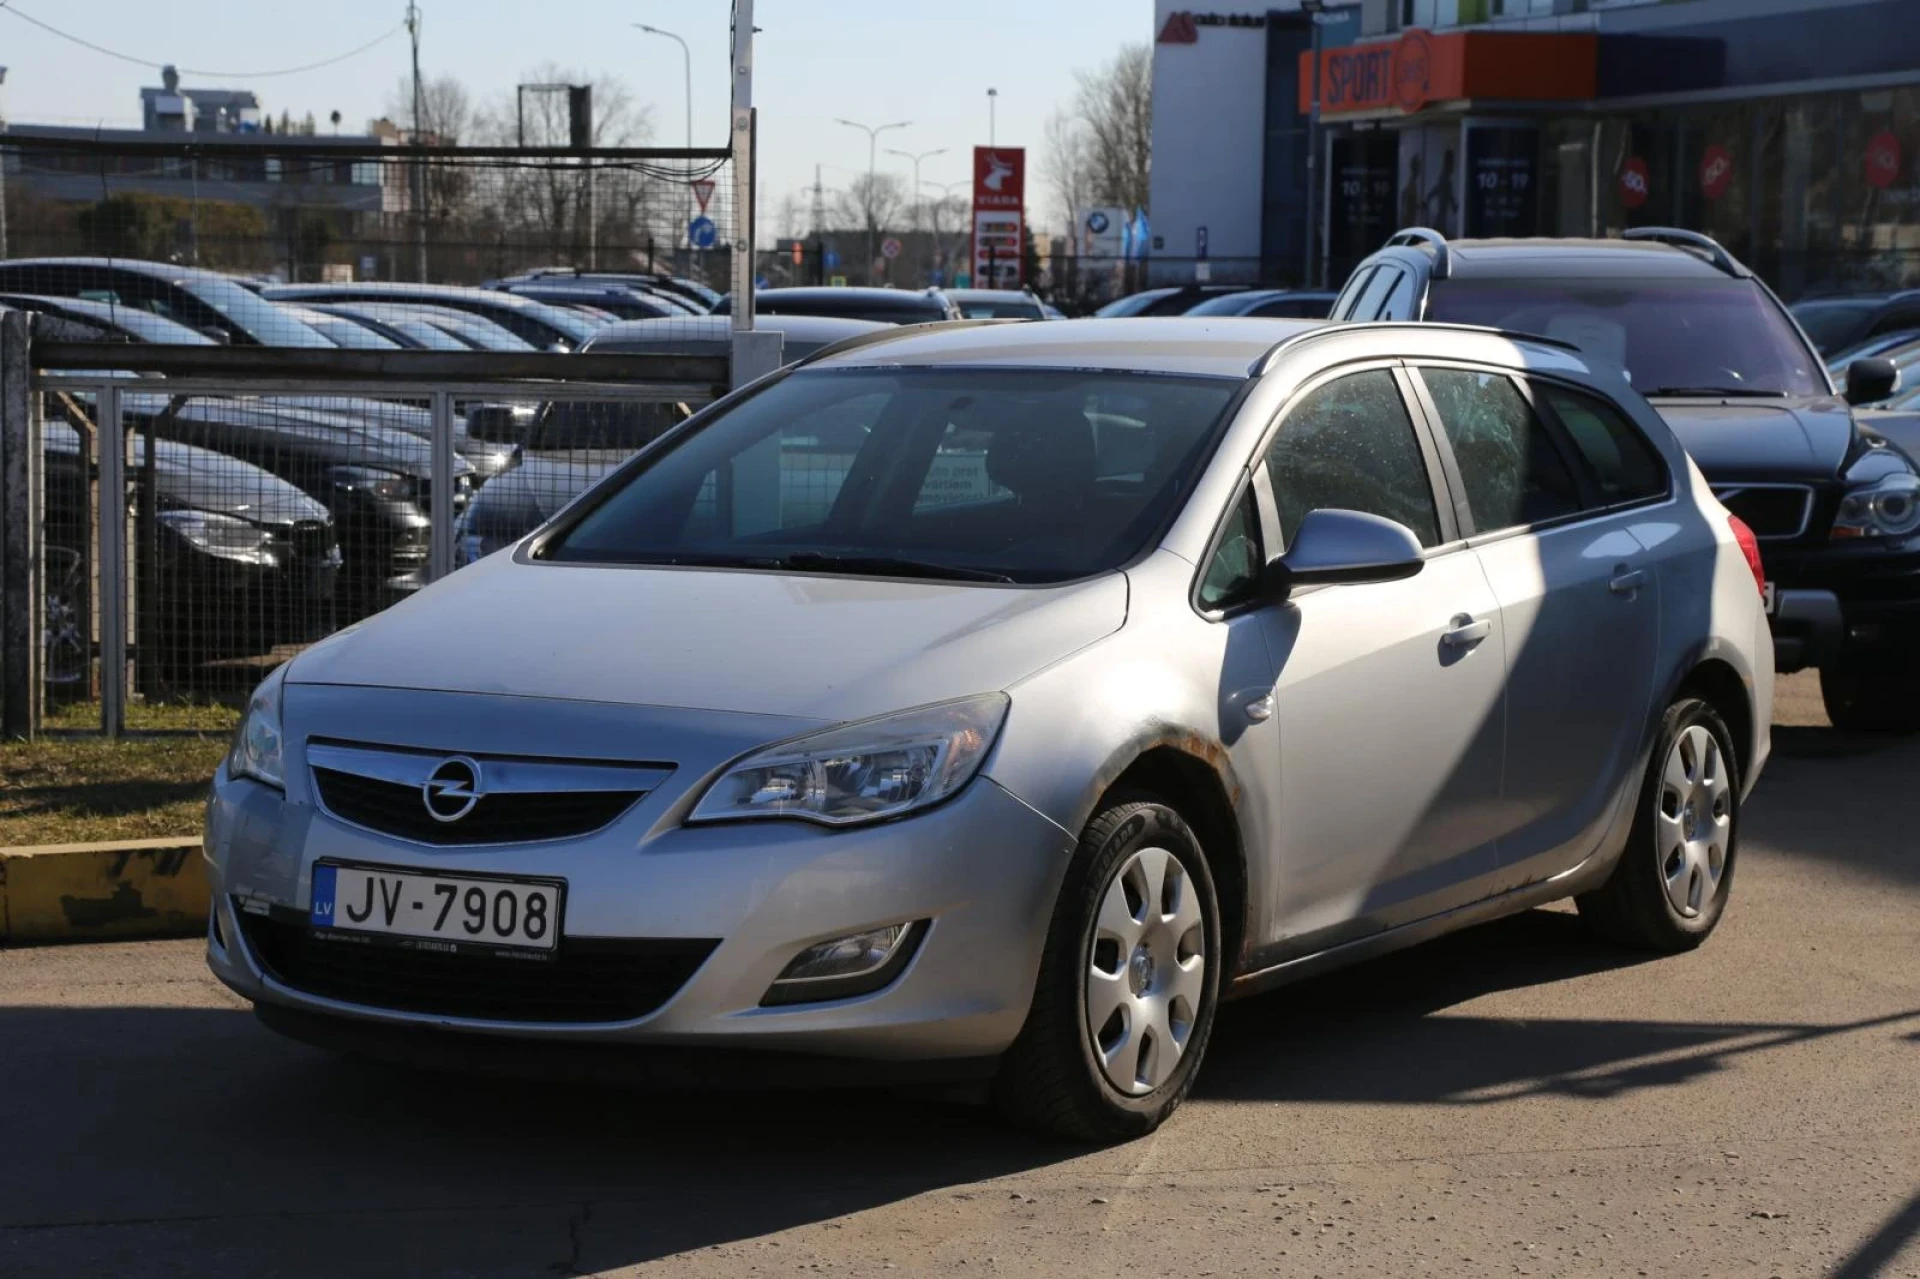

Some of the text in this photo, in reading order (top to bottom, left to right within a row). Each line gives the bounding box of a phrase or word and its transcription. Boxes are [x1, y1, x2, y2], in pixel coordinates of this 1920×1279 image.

[1328, 49, 1391, 104] SPORT
[1340, 180, 1361, 196] 10
[1476, 170, 1498, 189] 10
[977, 196, 1018, 205] VIADA
[315, 901, 332, 916] LV
[345, 877, 548, 940] JV-7908
